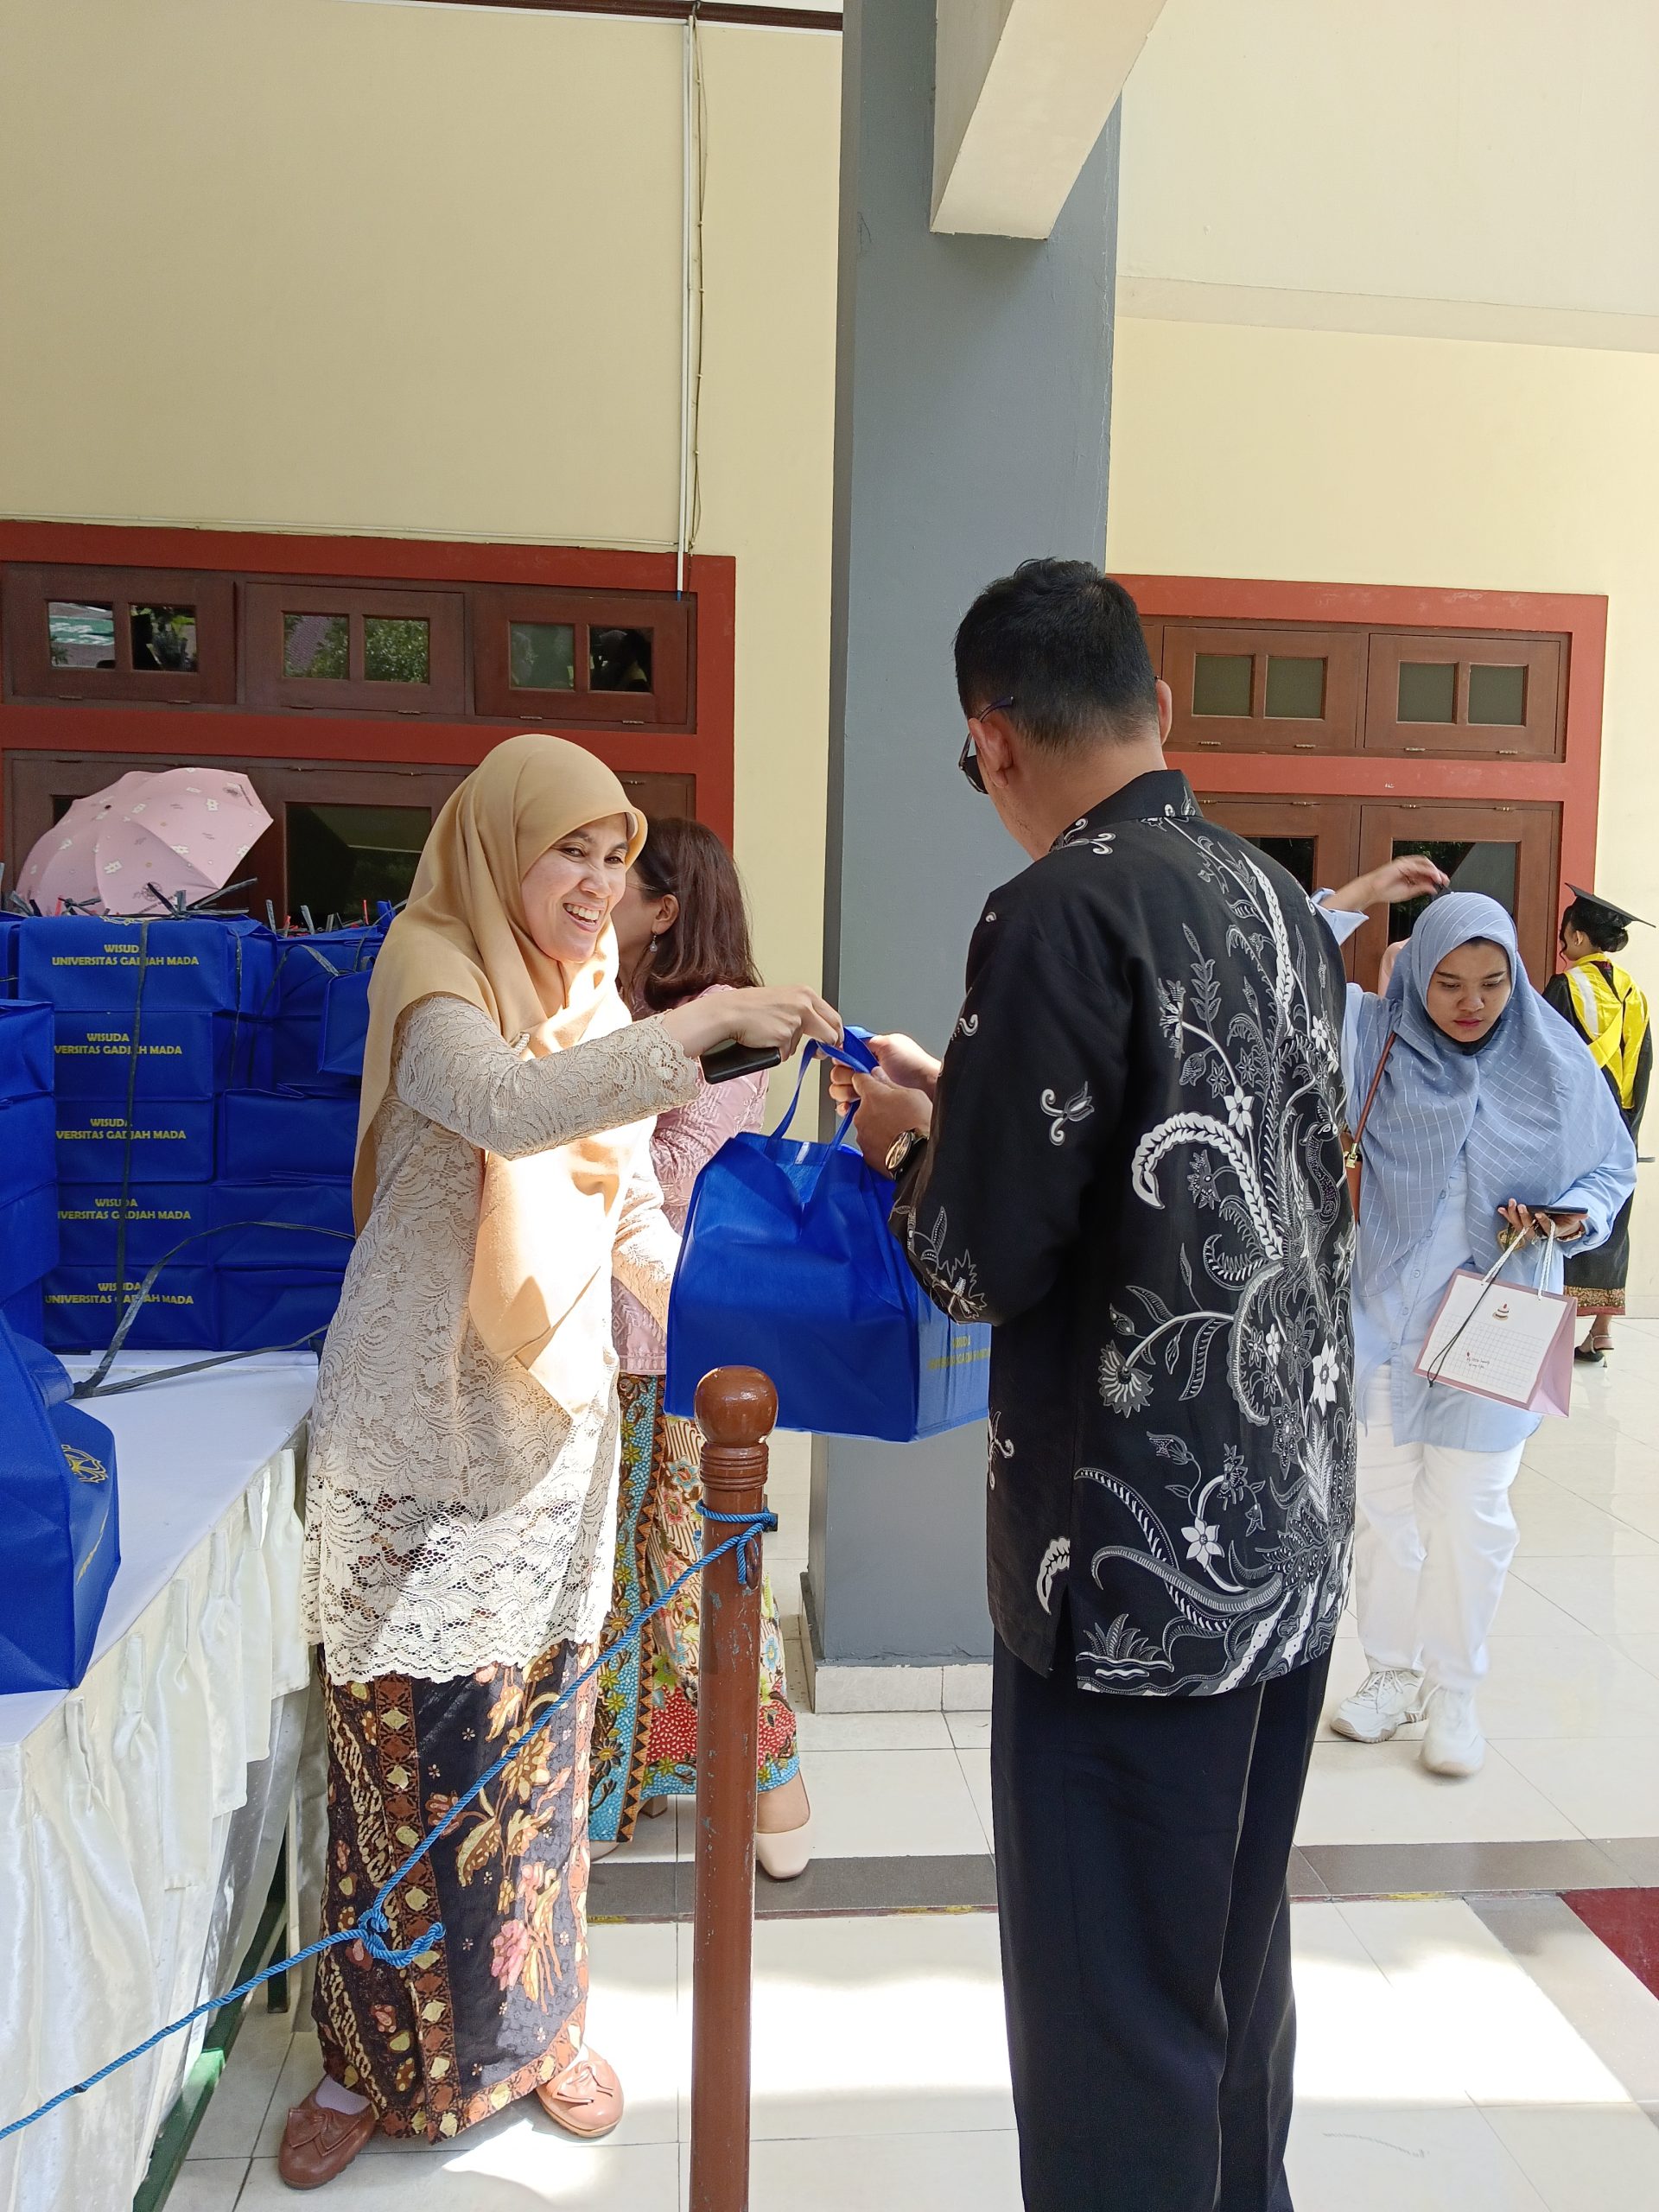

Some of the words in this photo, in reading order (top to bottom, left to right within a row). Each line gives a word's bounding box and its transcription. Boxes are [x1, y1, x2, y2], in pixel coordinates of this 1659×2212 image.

[104, 944, 141, 954] WISUD
[52, 957, 117, 966] UNIVERSITAS
[167, 957, 200, 966] MADA
[86, 1033, 130, 1042] WISUDA
[54, 1046, 100, 1054] VERSITAS
[103, 1046, 148, 1055] GADJH
[149, 1046, 182, 1054] MADA
[55, 1130, 104, 1140] VERSITAS
[153, 1130, 187, 1140] MADA
[57, 1211, 108, 1220] IVERSITAS
[111, 1211, 156, 1220] GDJAH
[157, 1211, 192, 1220] MADA
[45, 1294, 111, 1304] UNIVERSITAS
